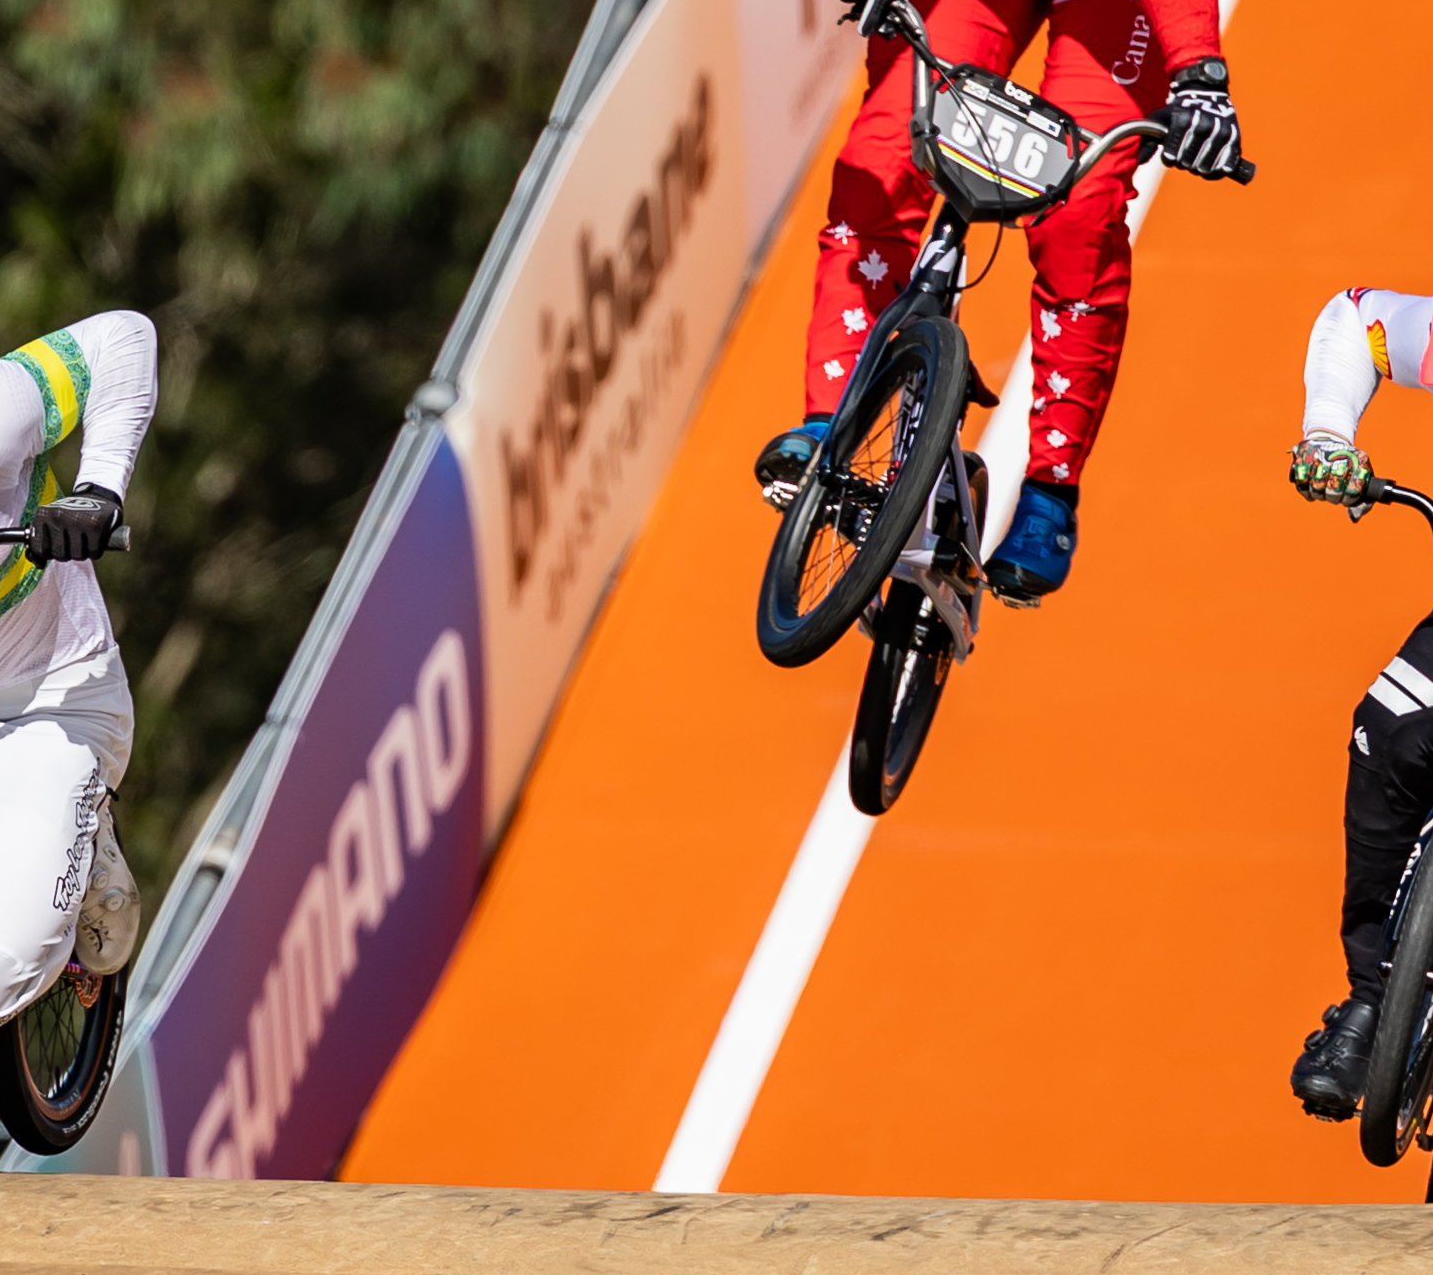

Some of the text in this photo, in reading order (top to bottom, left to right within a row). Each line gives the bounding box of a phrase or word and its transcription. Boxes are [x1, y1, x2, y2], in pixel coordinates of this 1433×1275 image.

[1004, 80, 1034, 105] box
[951, 99, 1049, 178] 556
[501, 68, 717, 609] brisbane
[52, 864, 81, 912] Troy
[185, 628, 473, 1181] SHIMANO
